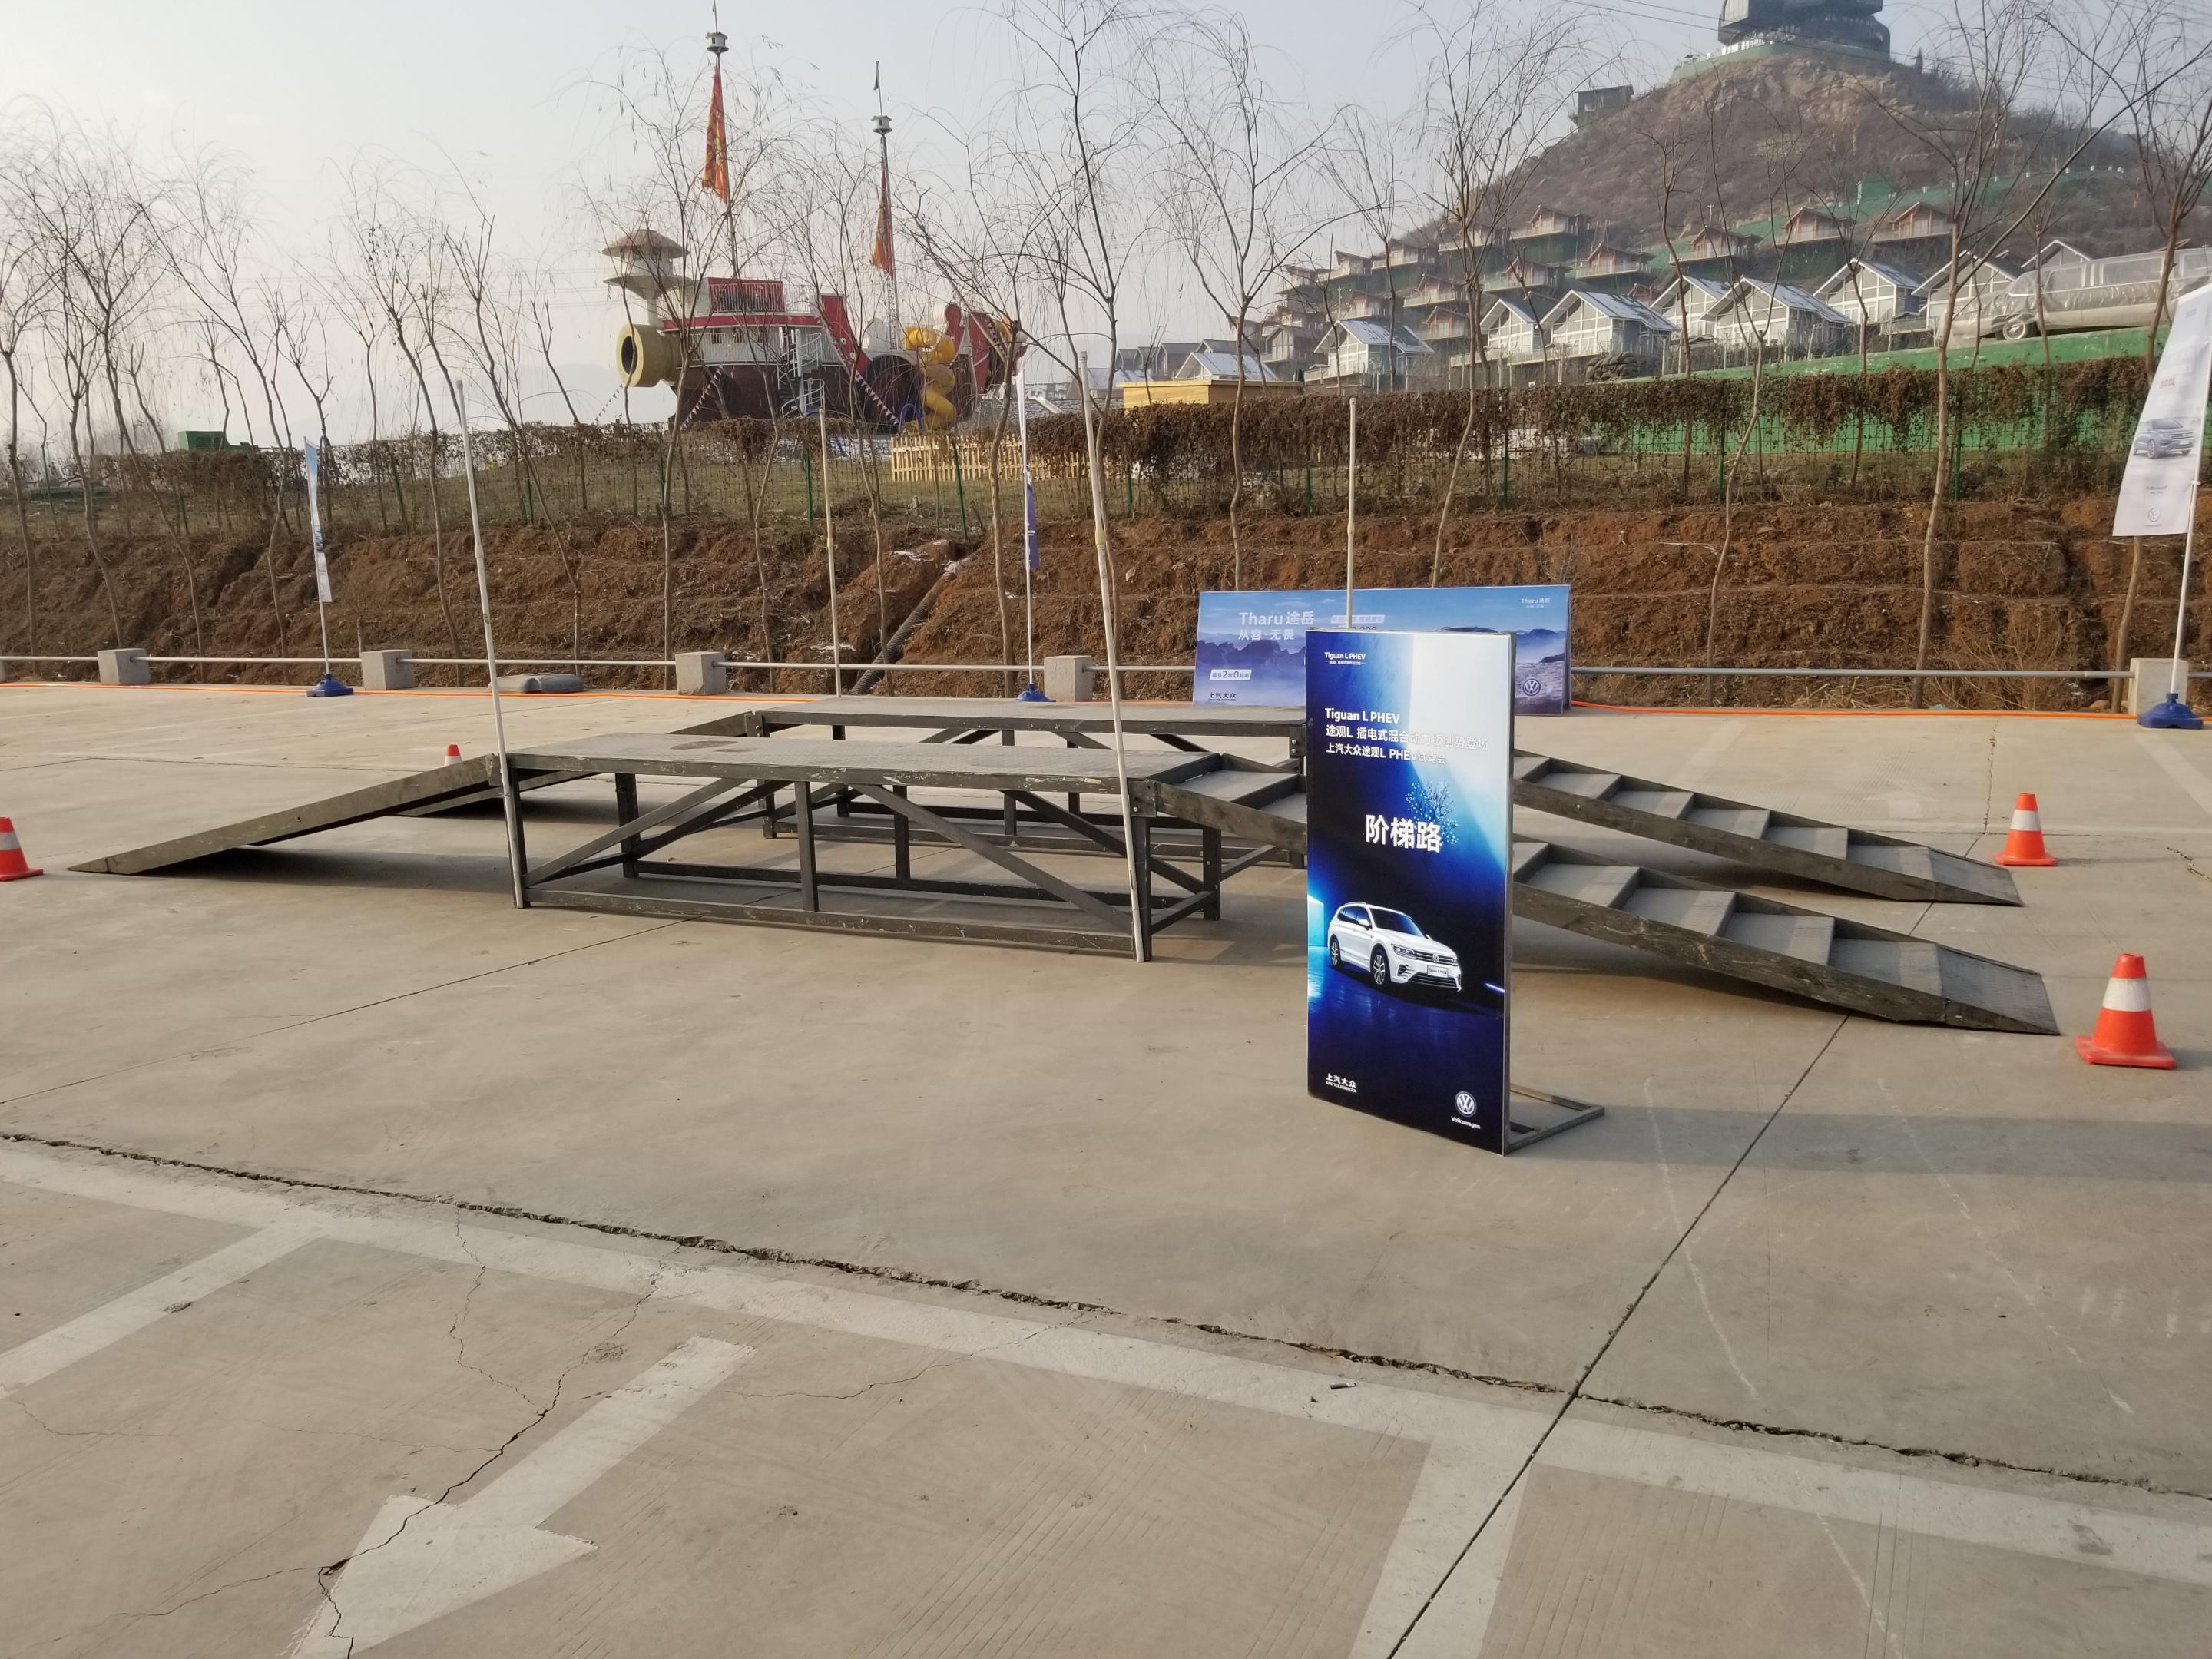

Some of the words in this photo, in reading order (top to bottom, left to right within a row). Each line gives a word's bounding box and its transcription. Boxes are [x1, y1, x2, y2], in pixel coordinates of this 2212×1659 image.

[1239, 611, 1283, 625] Tharu
[1286, 611, 1315, 625] 途岳
[1324, 651, 1344, 660] Tiguan
[1325, 707, 1359, 722] Tiguan
[1363, 710, 1369, 721] L
[1370, 711, 1400, 724] PHEV
[1326, 724, 1353, 738] 途观L
[1356, 727, 1488, 750] 插电式混合动力版创势登场
[1326, 742, 1387, 759] 上汽大众途观L
[1389, 748, 1447, 765] PHEV试驾会
[1366, 814, 1442, 853] 阶梯路
[1326, 1072, 1357, 1089] 上汽大众
